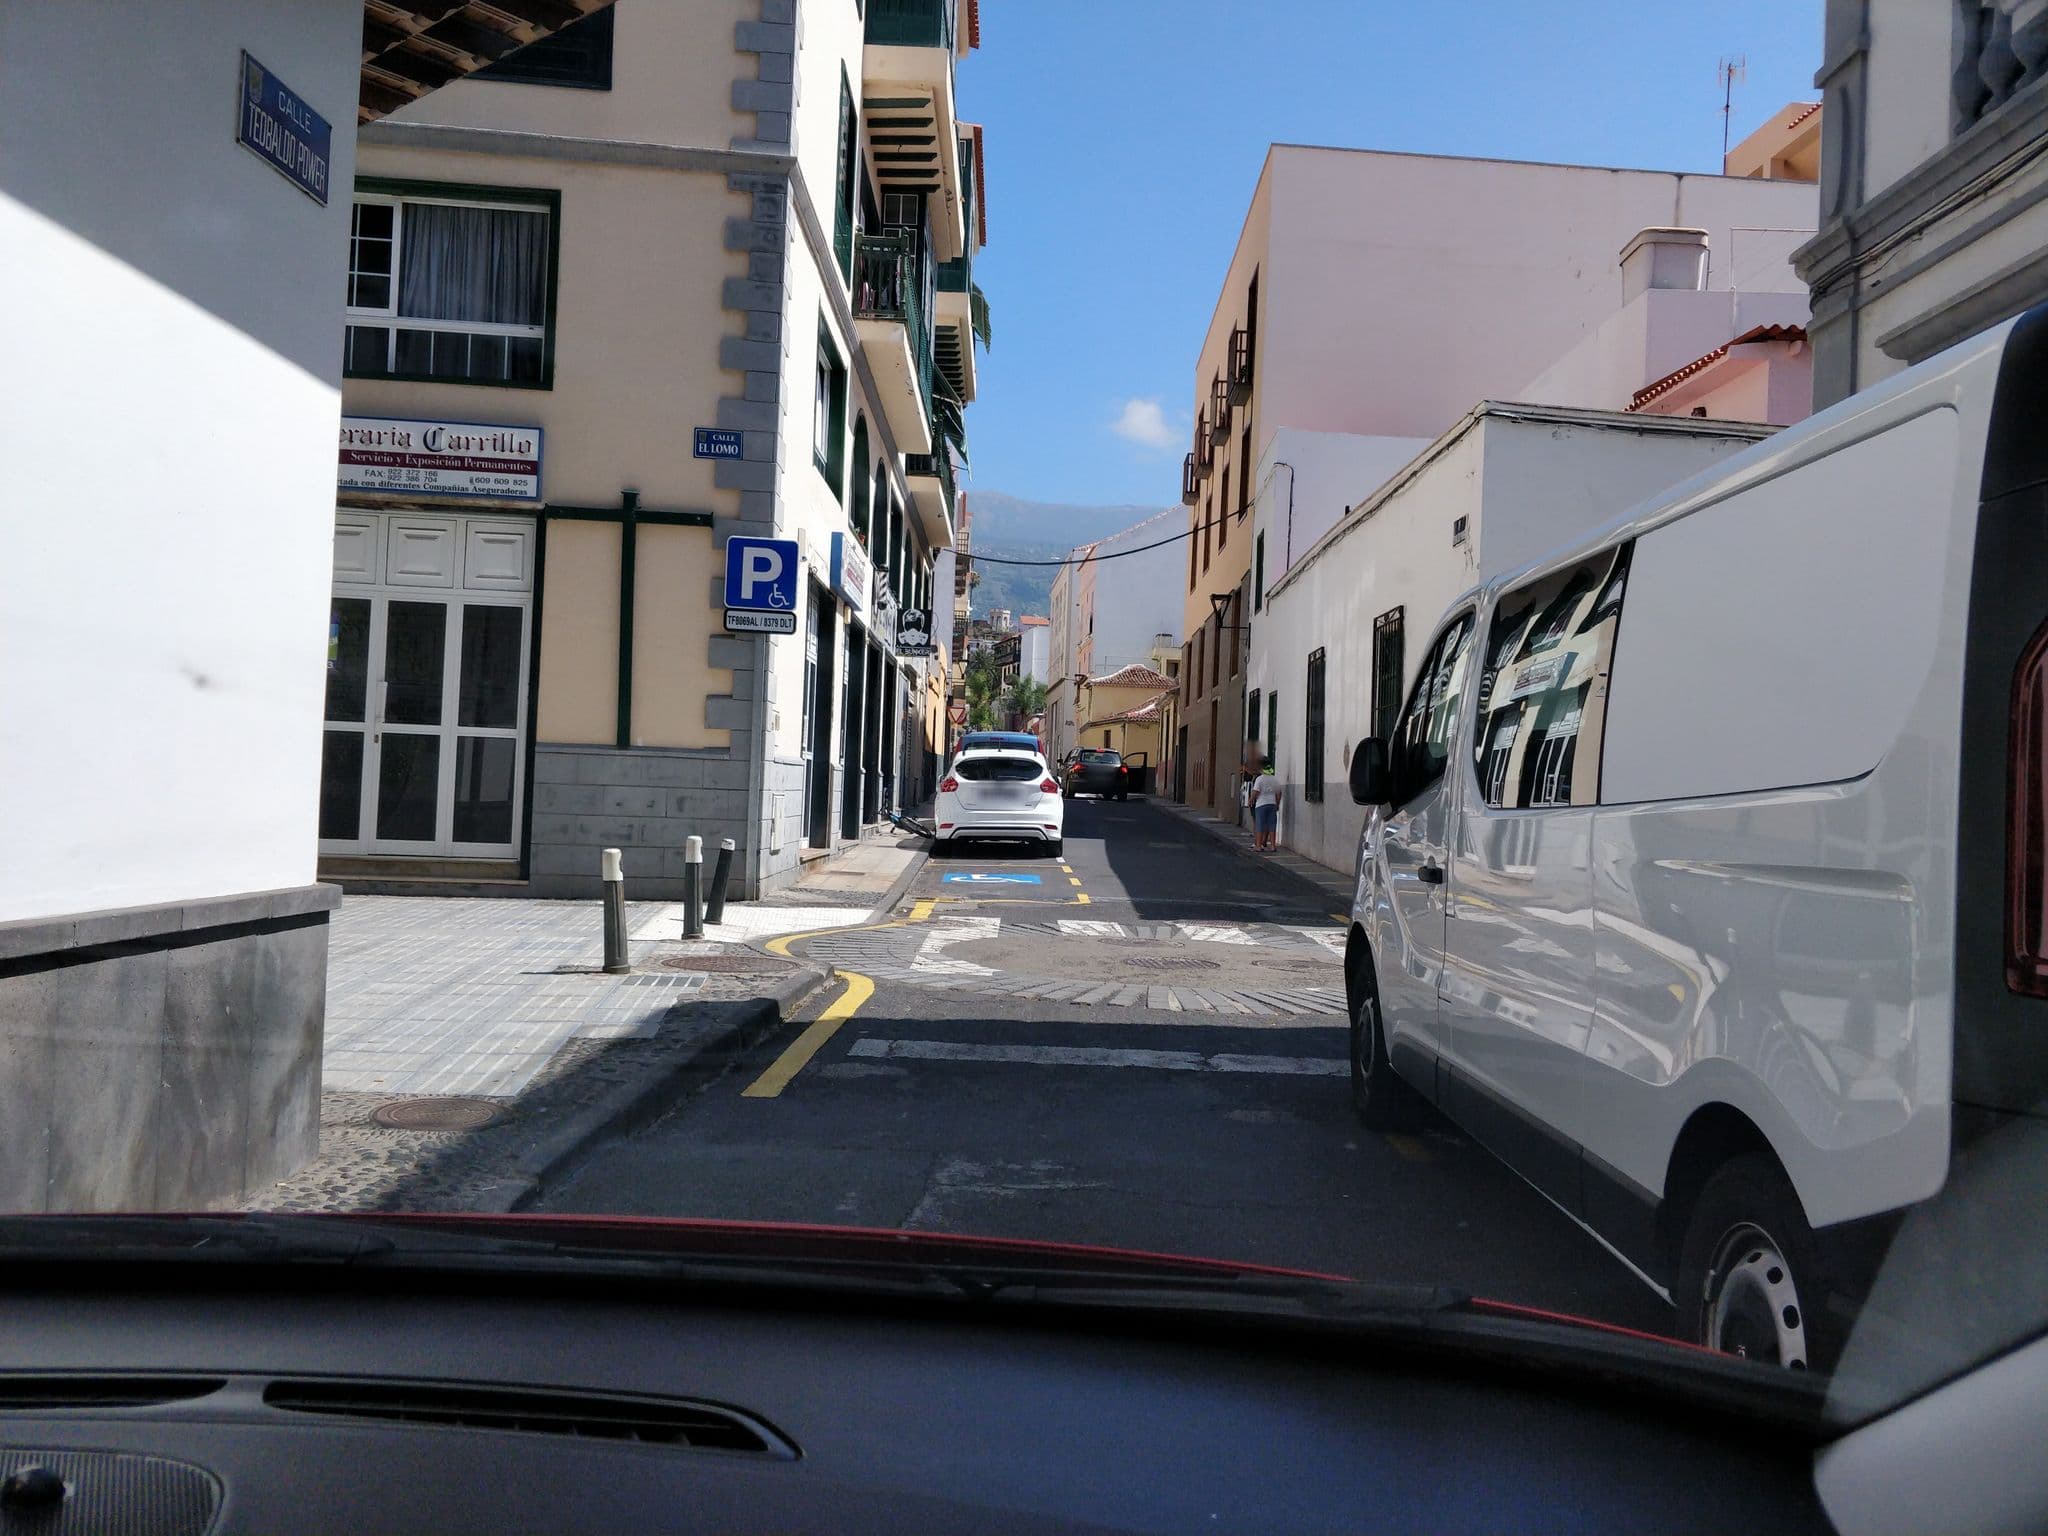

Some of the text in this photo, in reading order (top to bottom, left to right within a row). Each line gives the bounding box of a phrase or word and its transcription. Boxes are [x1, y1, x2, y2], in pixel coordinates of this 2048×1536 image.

[278, 91, 311, 134] CALLE
[249, 102, 326, 194] TEOBALDO POWER
[422, 425, 532, 454] Carrillo
[699, 443, 738, 455] EL LOMO
[713, 434, 735, 442] CALLE
[350, 451, 532, 471] Servicio y Exposición Permanentes
[379, 480, 421, 489] diferentes
[472, 485, 528, 496] Aseguradoras
[741, 547, 782, 600] P
